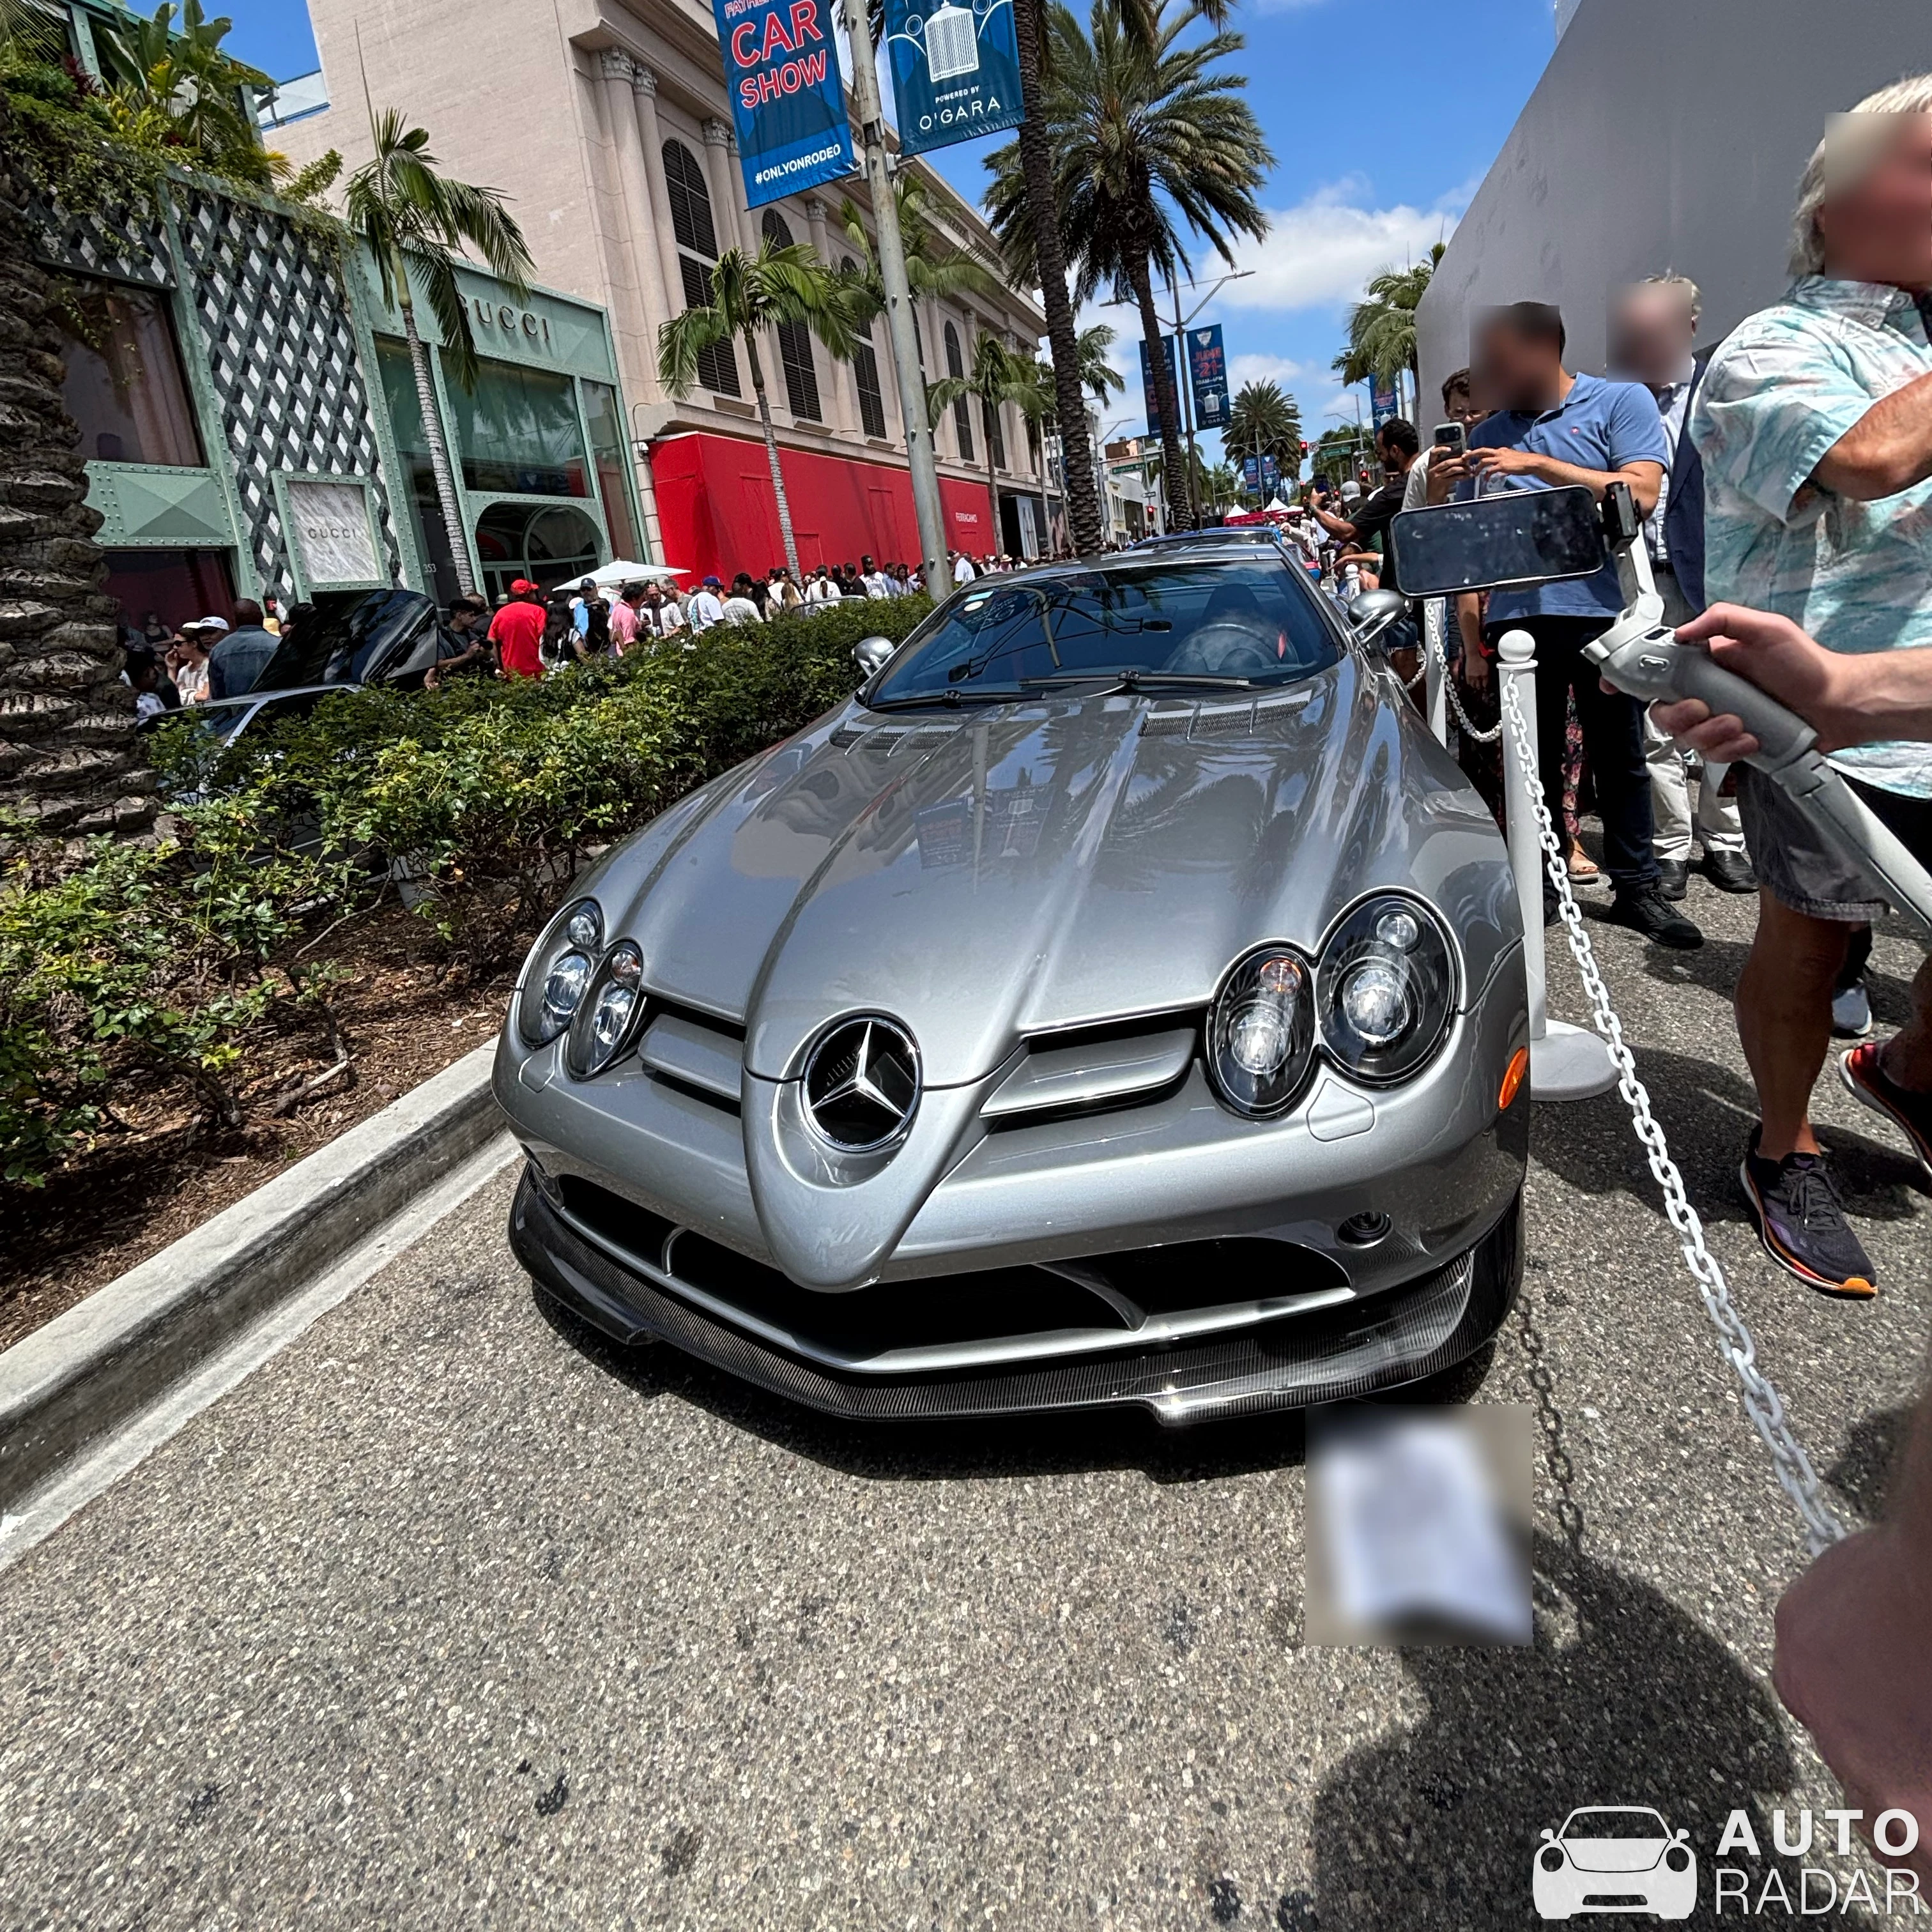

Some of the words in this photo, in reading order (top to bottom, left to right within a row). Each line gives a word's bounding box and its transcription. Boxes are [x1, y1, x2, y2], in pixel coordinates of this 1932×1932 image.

[732, 0, 824, 68] CAR
[740, 49, 826, 109] SHOW
[935, 88, 969, 104] POWERED
[970, 85, 979, 95] BY
[919, 96, 1000, 130] O'GARA
[755, 143, 841, 185] #ONLYONRODEO
[1199, 360, 1218, 378] 21
[308, 528, 356, 539] GUCCI
[423, 563, 437, 573] 353
